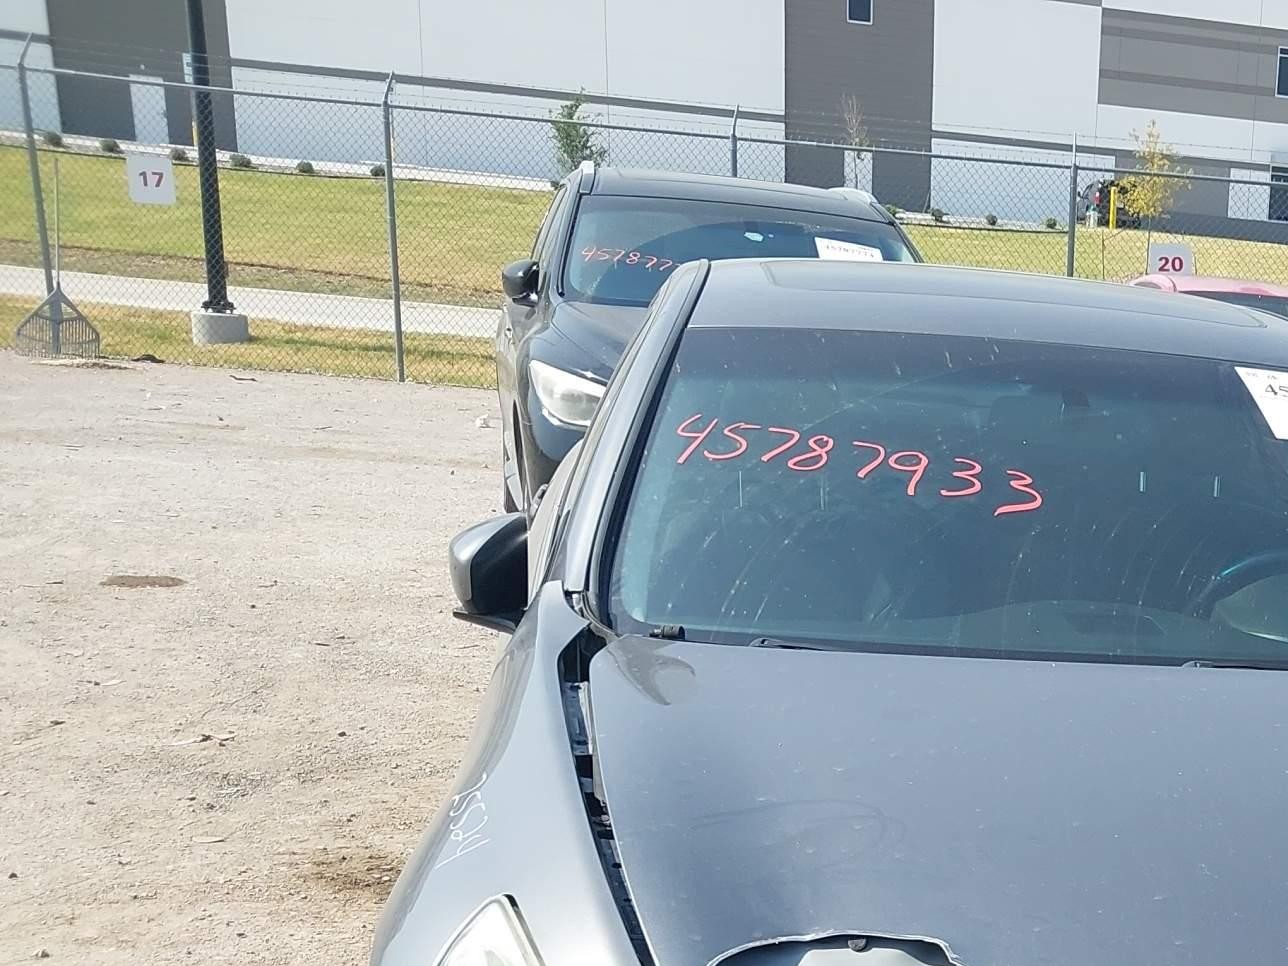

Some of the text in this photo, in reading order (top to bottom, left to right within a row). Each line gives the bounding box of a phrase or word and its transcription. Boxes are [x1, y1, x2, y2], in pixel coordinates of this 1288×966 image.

[138, 171, 164, 188] 17
[581, 245, 681, 271] 457877
[1158, 256, 1184, 272] 20
[676, 413, 1043, 517] 45787933
